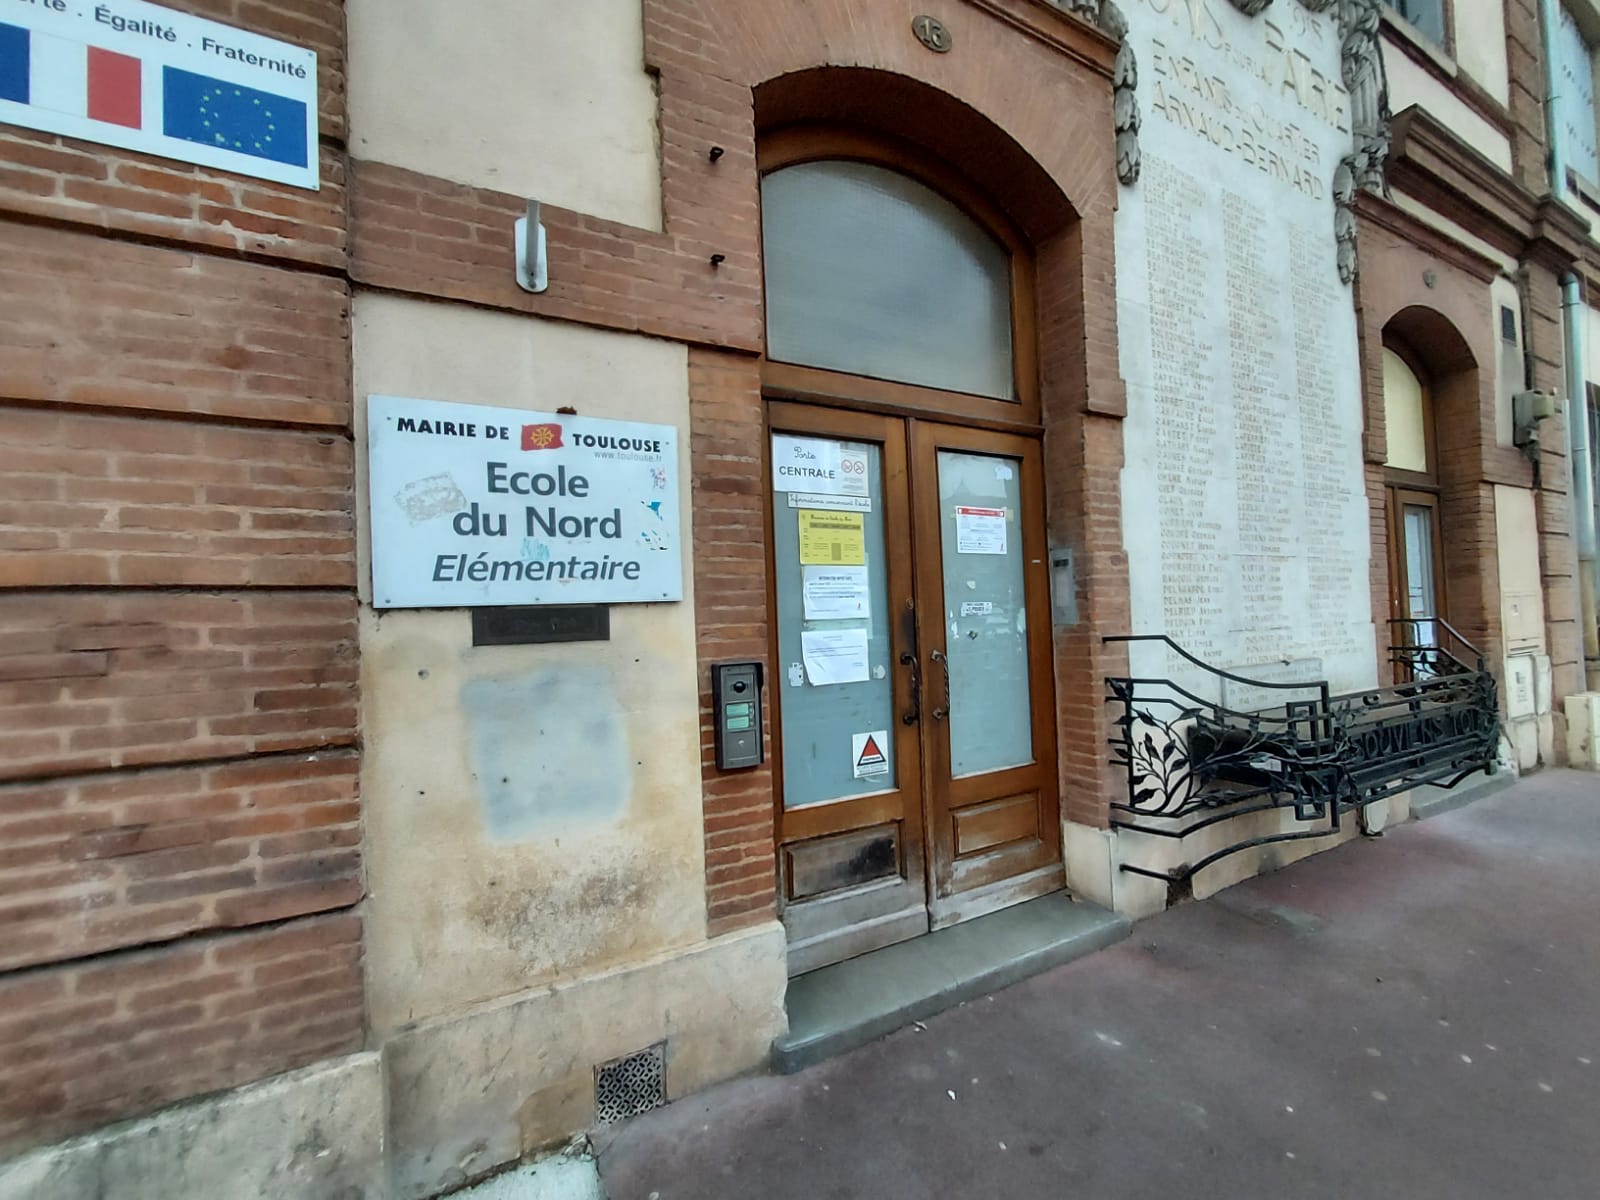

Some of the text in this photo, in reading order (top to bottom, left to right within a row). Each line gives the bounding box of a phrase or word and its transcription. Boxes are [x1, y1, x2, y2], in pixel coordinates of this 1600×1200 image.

[94, 4, 307, 80] Égalité Fraternité
[1151, 37, 1233, 113] ENFANTS
[397, 417, 661, 453] MAIRIE DE TOULOUSE
[793, 446, 816, 460] Porte
[594, 451, 663, 464] www.toulouse.fr
[779, 466, 836, 479] CENTRALE
[486, 461, 590, 499] Ecole
[452, 502, 622, 539] du Nord
[431, 552, 641, 583] Elémentaire
